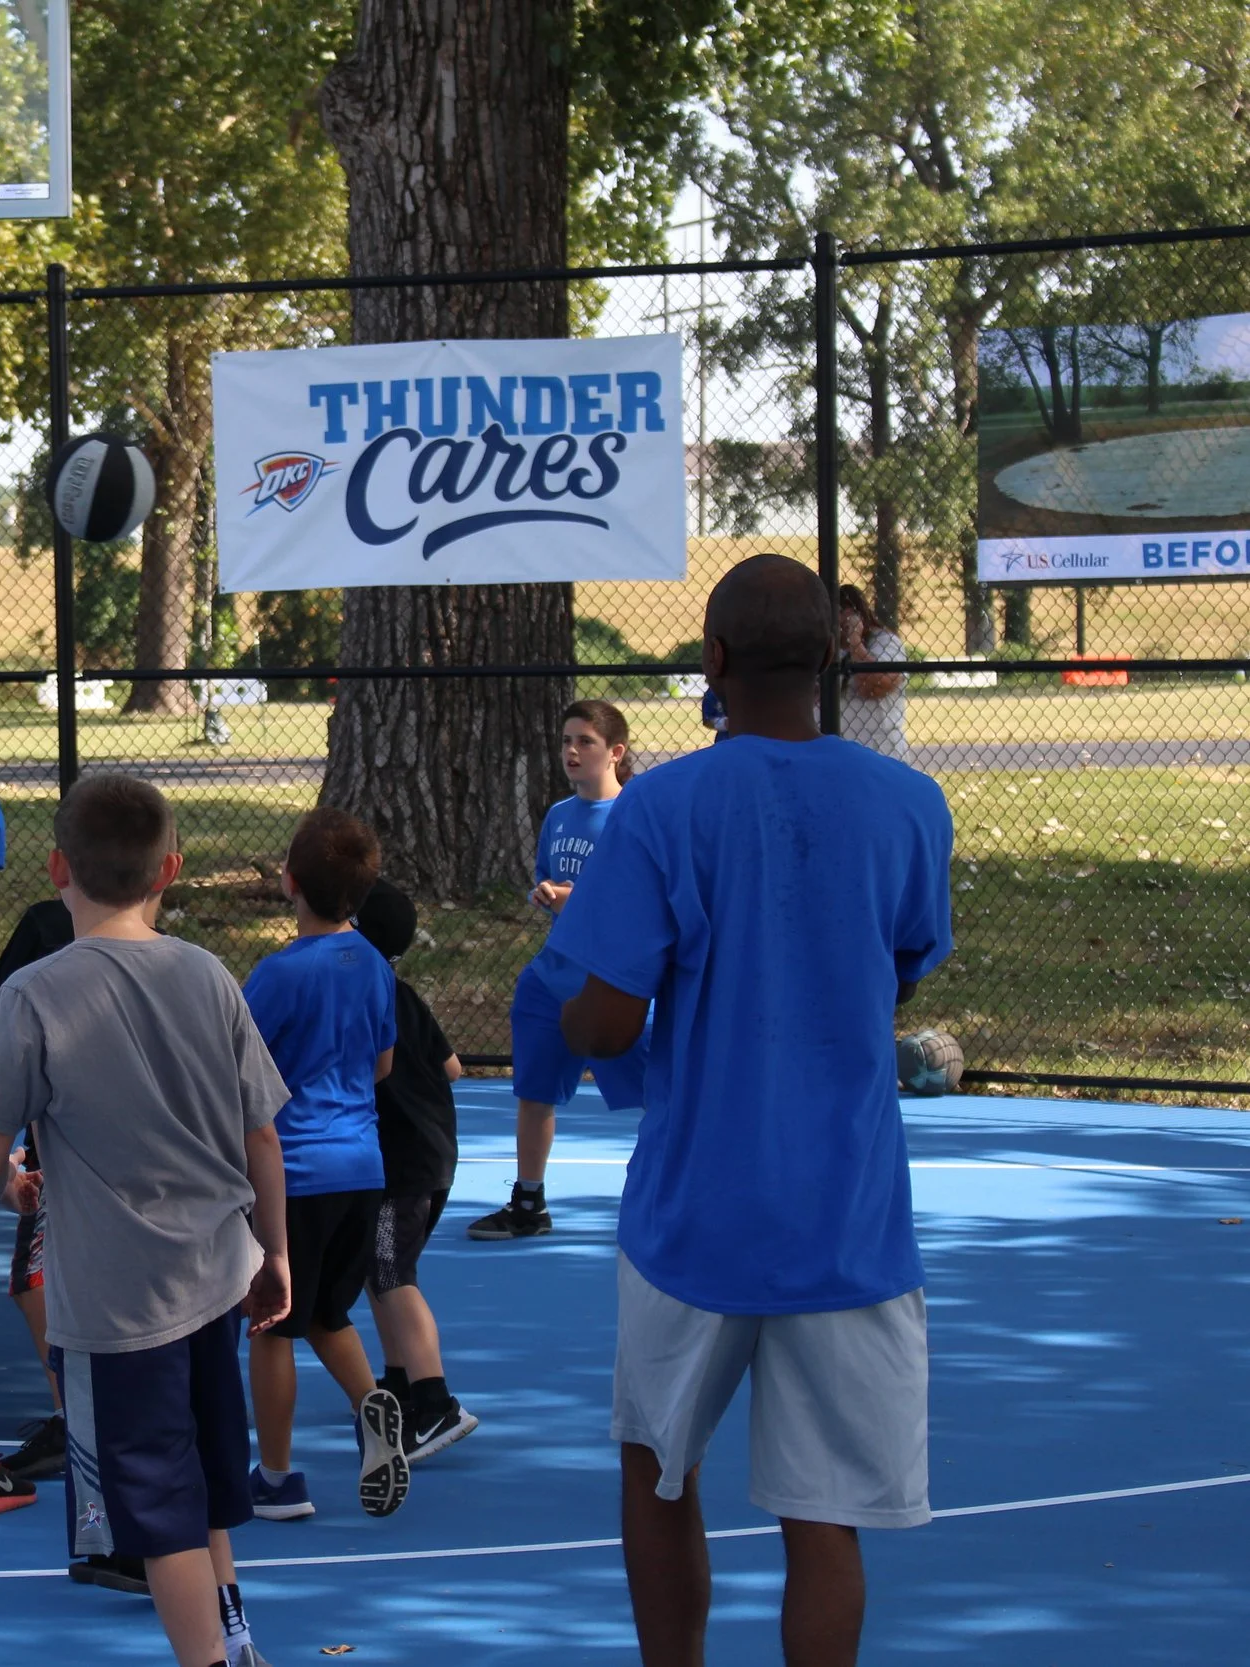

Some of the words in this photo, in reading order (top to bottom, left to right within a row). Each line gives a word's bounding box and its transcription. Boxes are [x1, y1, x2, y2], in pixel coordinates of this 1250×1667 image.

[308, 371, 665, 443] THUNDER
[255, 462, 310, 503] OKC
[345, 422, 627, 545] Cares
[1051, 552, 1109, 569] Cellular
[560, 857, 582, 875] CITY
